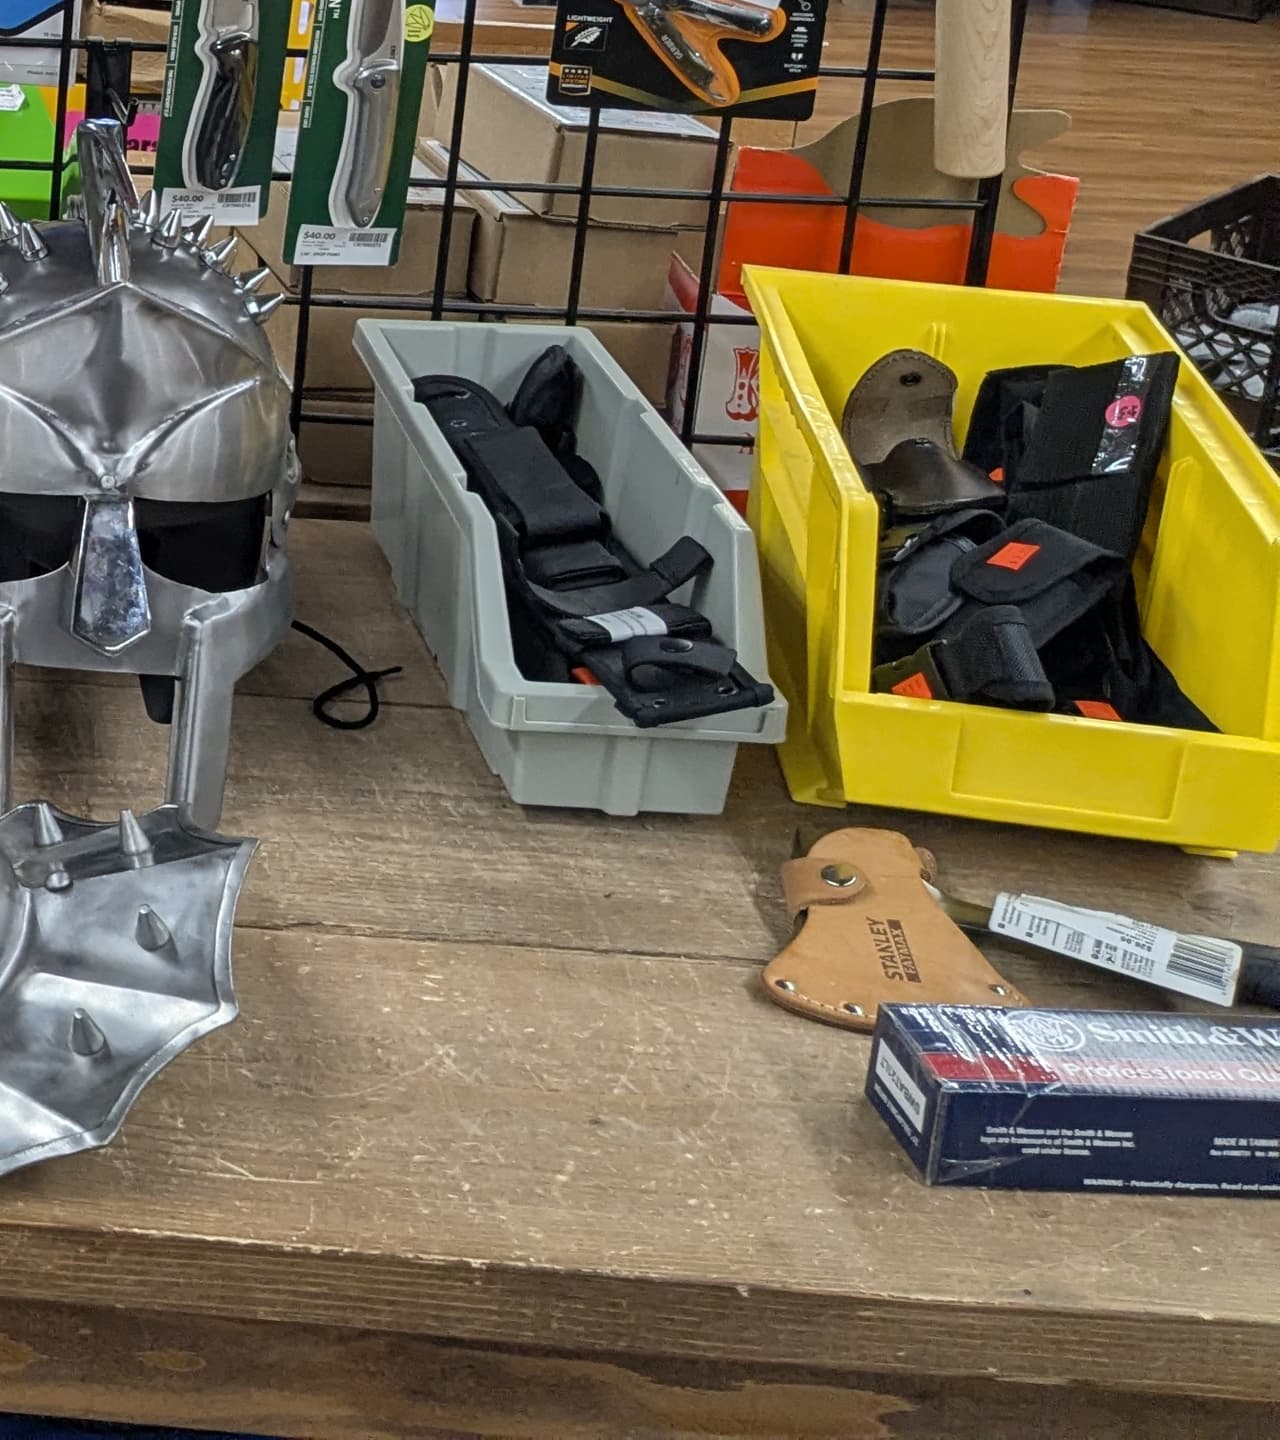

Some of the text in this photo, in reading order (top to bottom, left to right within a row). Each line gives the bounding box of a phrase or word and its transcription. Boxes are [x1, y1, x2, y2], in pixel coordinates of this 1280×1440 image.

[567, 14, 614, 24] LIGHTWEIGHT
[869, 916, 904, 981] STANLEY
[890, 918, 921, 983] FATMAX
[1065, 1062, 1231, 1083] Professional
